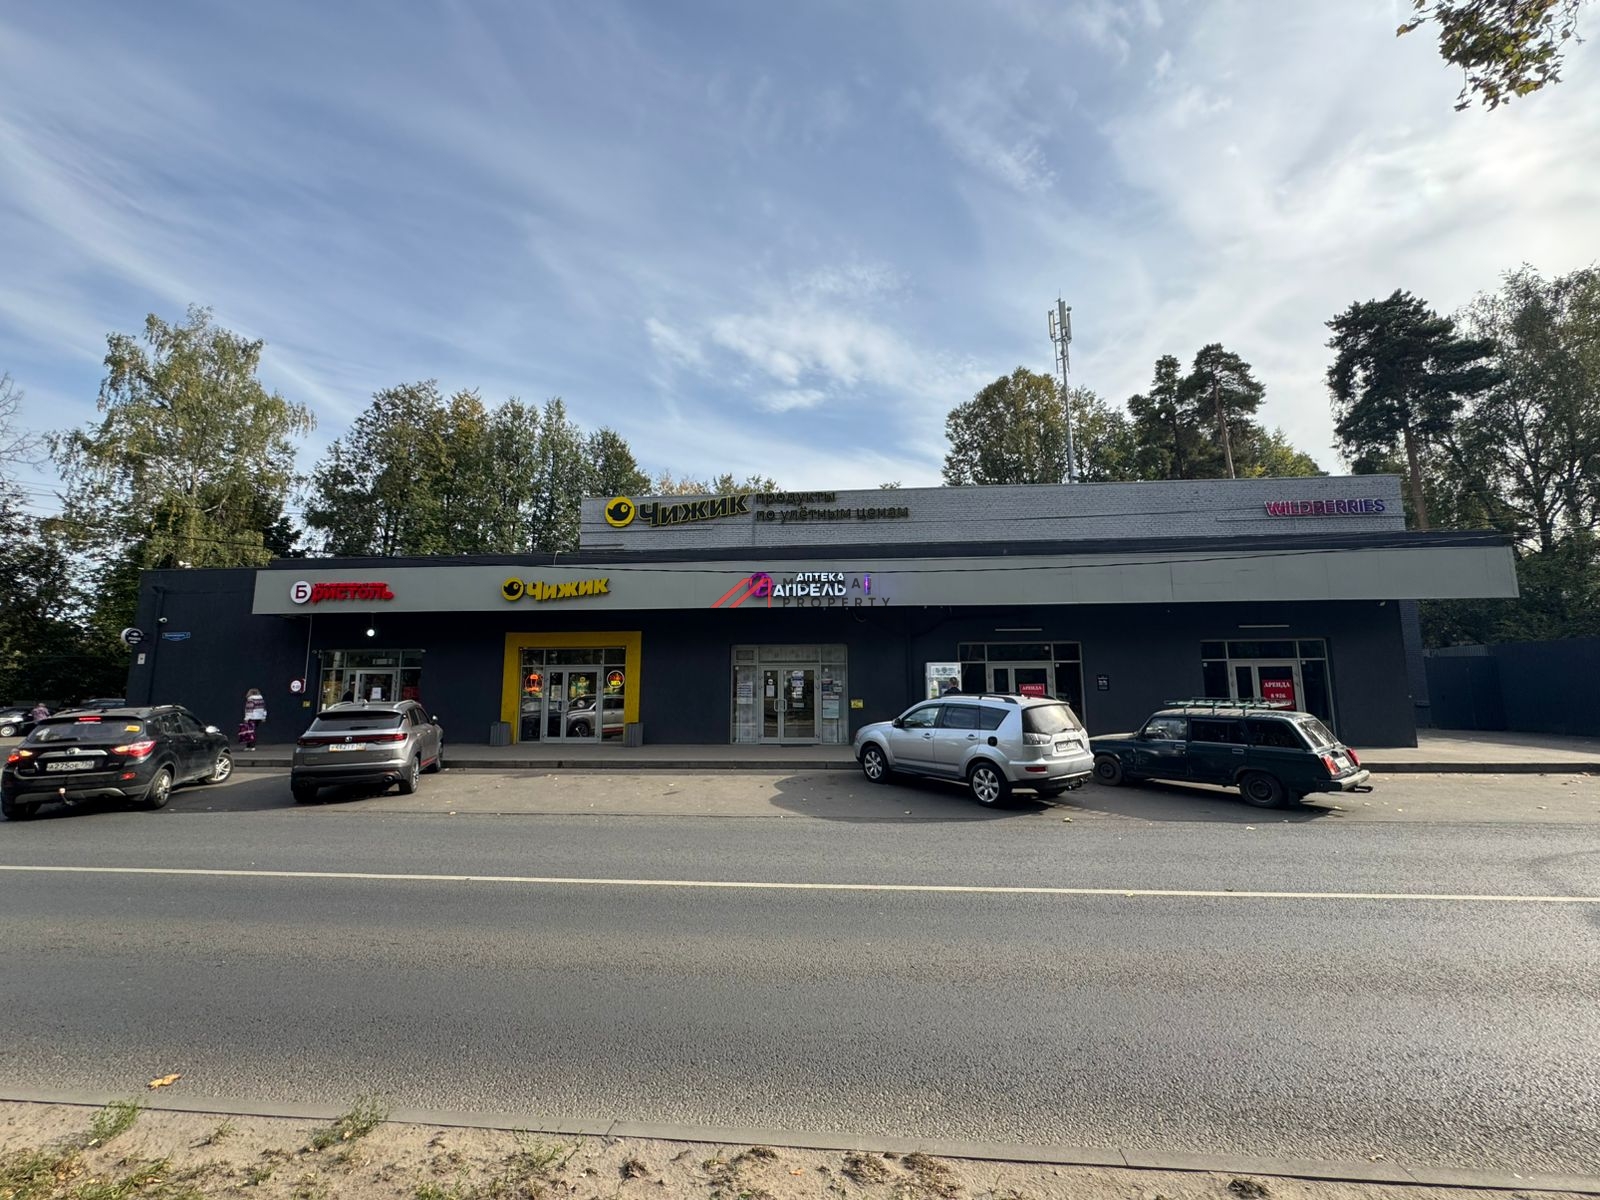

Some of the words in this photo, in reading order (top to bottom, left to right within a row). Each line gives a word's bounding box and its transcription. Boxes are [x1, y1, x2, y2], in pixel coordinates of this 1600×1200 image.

[755, 492, 837, 507] продукты
[1264, 499, 1386, 517] WILDBERRIES
[639, 494, 750, 527] Чижик
[756, 509, 776, 522] по
[780, 506, 851, 524] улётным
[856, 506, 909, 521] ценам
[796, 572, 845, 582] АПТЕКА
[526, 577, 610, 601] Чижик
[773, 583, 847, 597] АПРЕЛЬ
